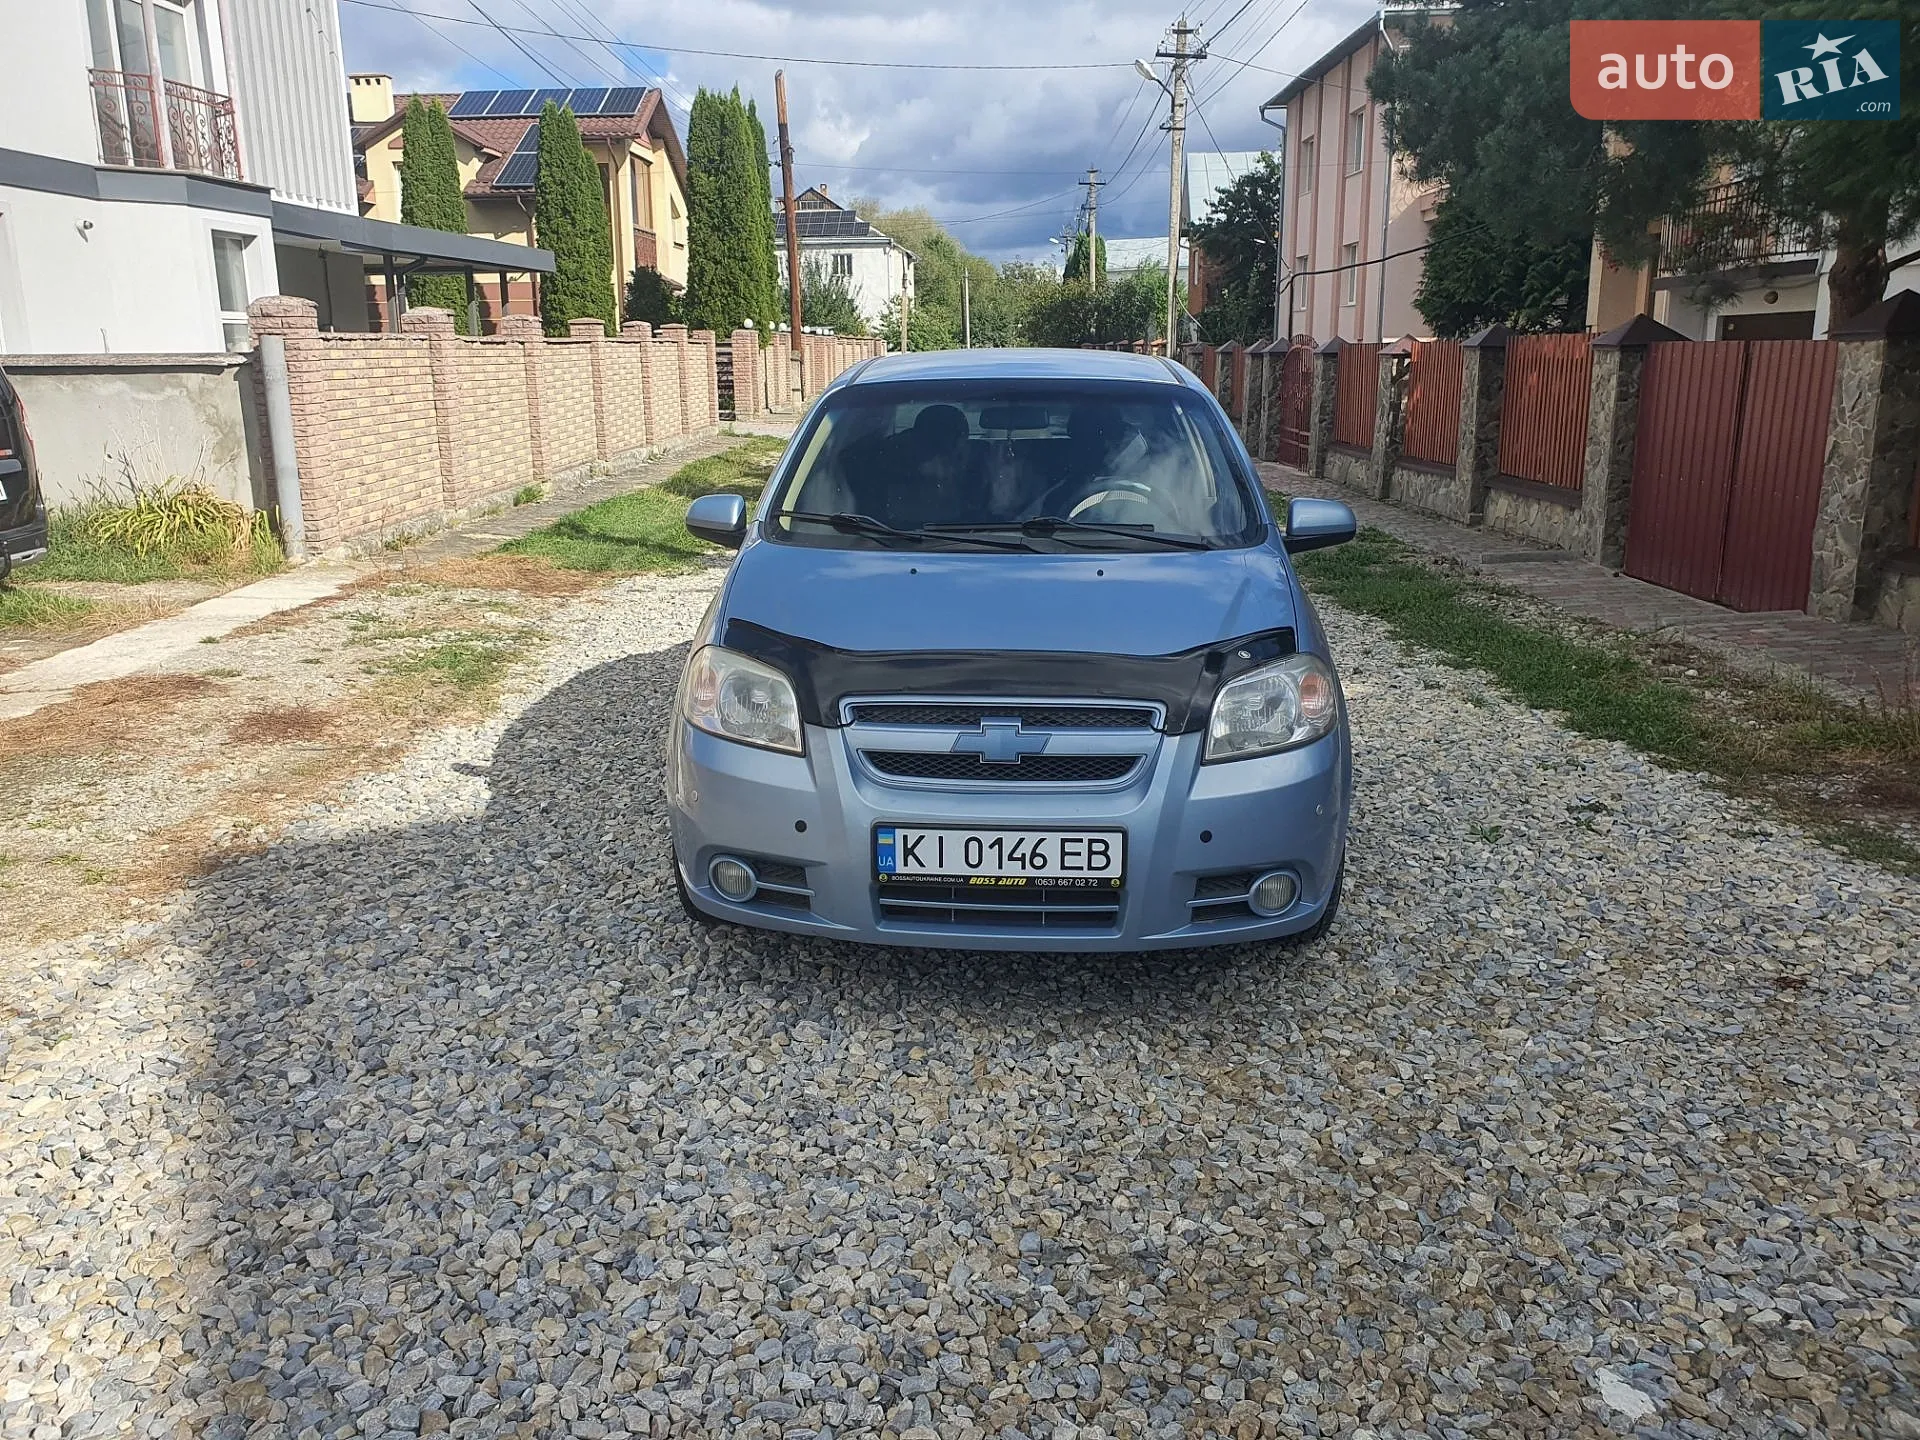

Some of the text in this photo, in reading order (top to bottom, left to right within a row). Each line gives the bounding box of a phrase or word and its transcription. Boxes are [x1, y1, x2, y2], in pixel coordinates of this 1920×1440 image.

[902, 834, 1112, 872] KI 0146 EB
[878, 855, 894, 867] UA
[969, 877, 996, 886] BOSS
[1034, 878, 1056, 887] (063)
[1057, 878, 1073, 887] 667
[1075, 879, 1086, 887] 02
[1087, 879, 1098, 887] 72
